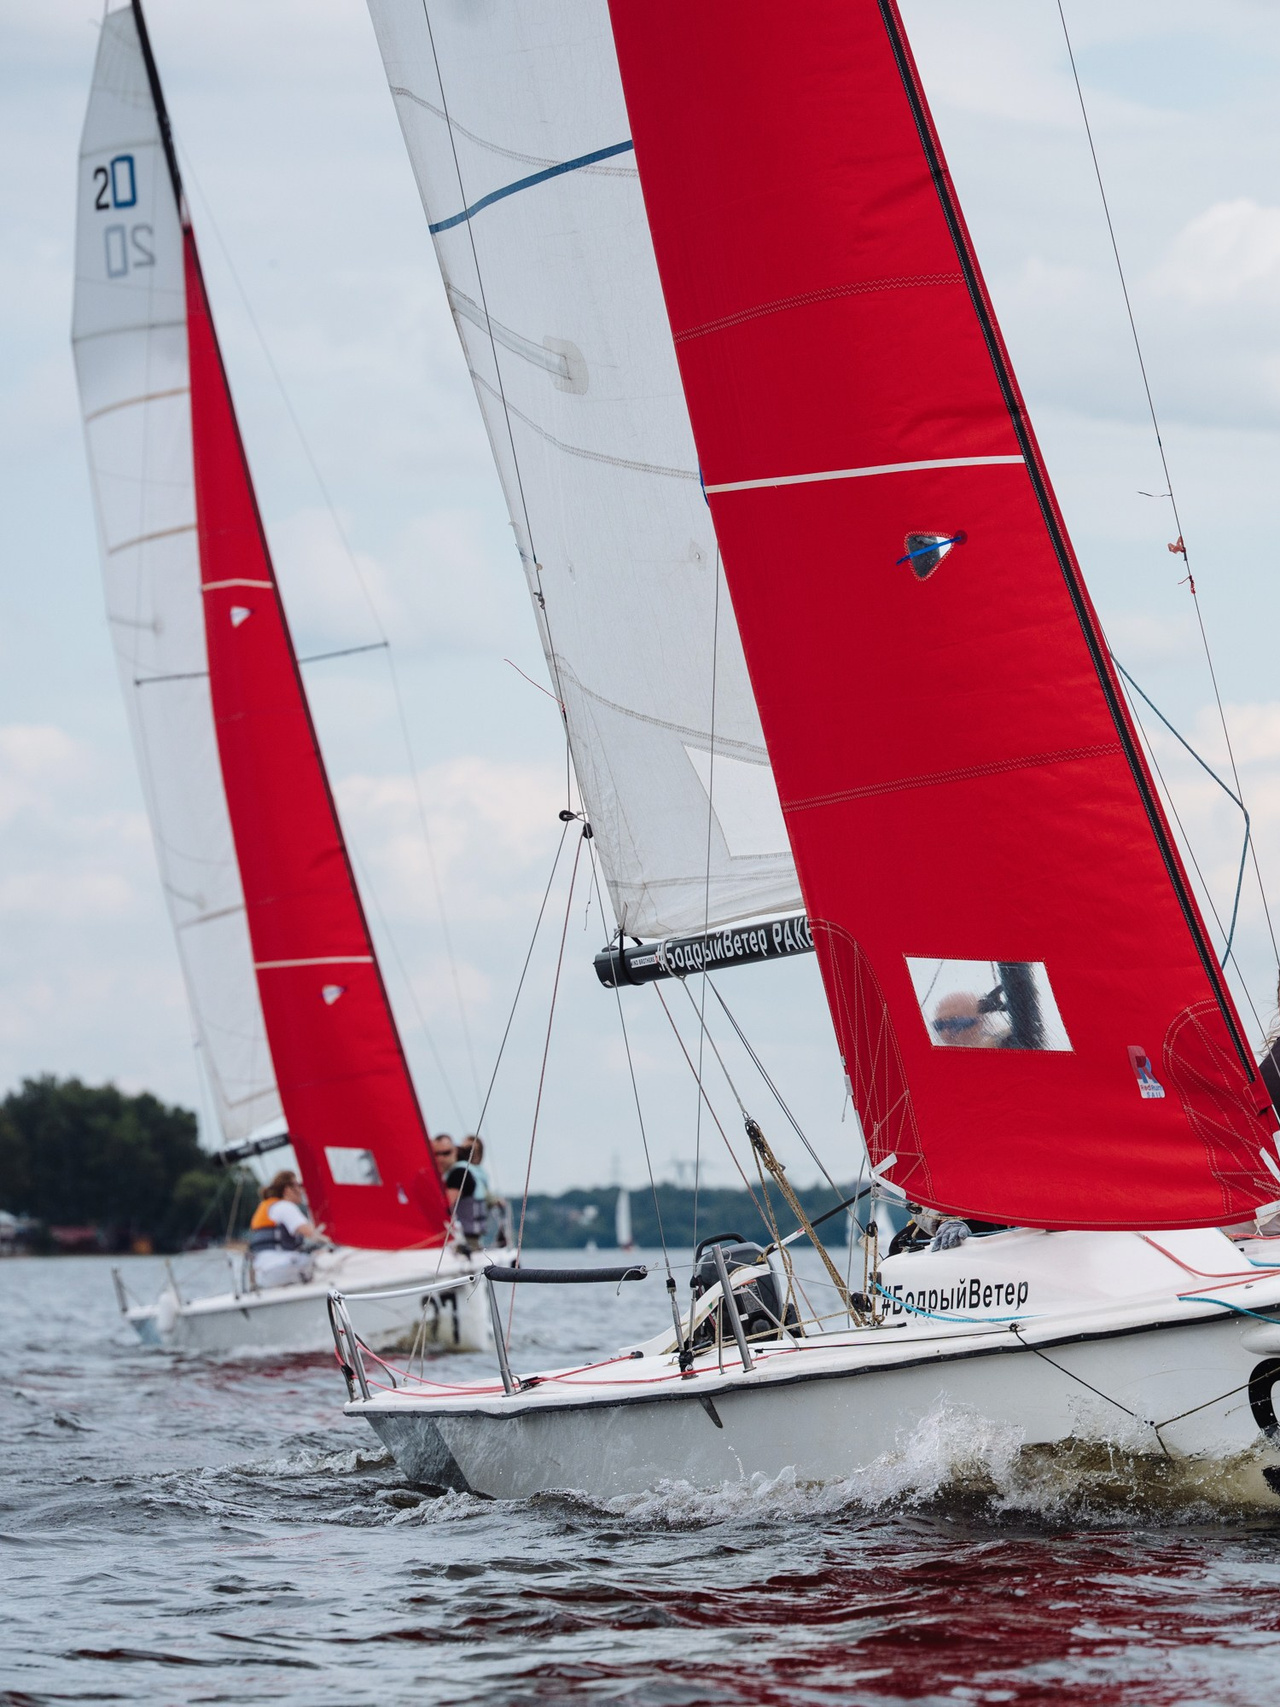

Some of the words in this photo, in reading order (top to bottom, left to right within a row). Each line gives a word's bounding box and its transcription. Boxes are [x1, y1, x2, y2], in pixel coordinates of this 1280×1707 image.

[93, 154, 137, 211] 20
[656, 929, 768, 972] #БодрыйВетер
[881, 1278, 1029, 1319] #БодрыйВетер
